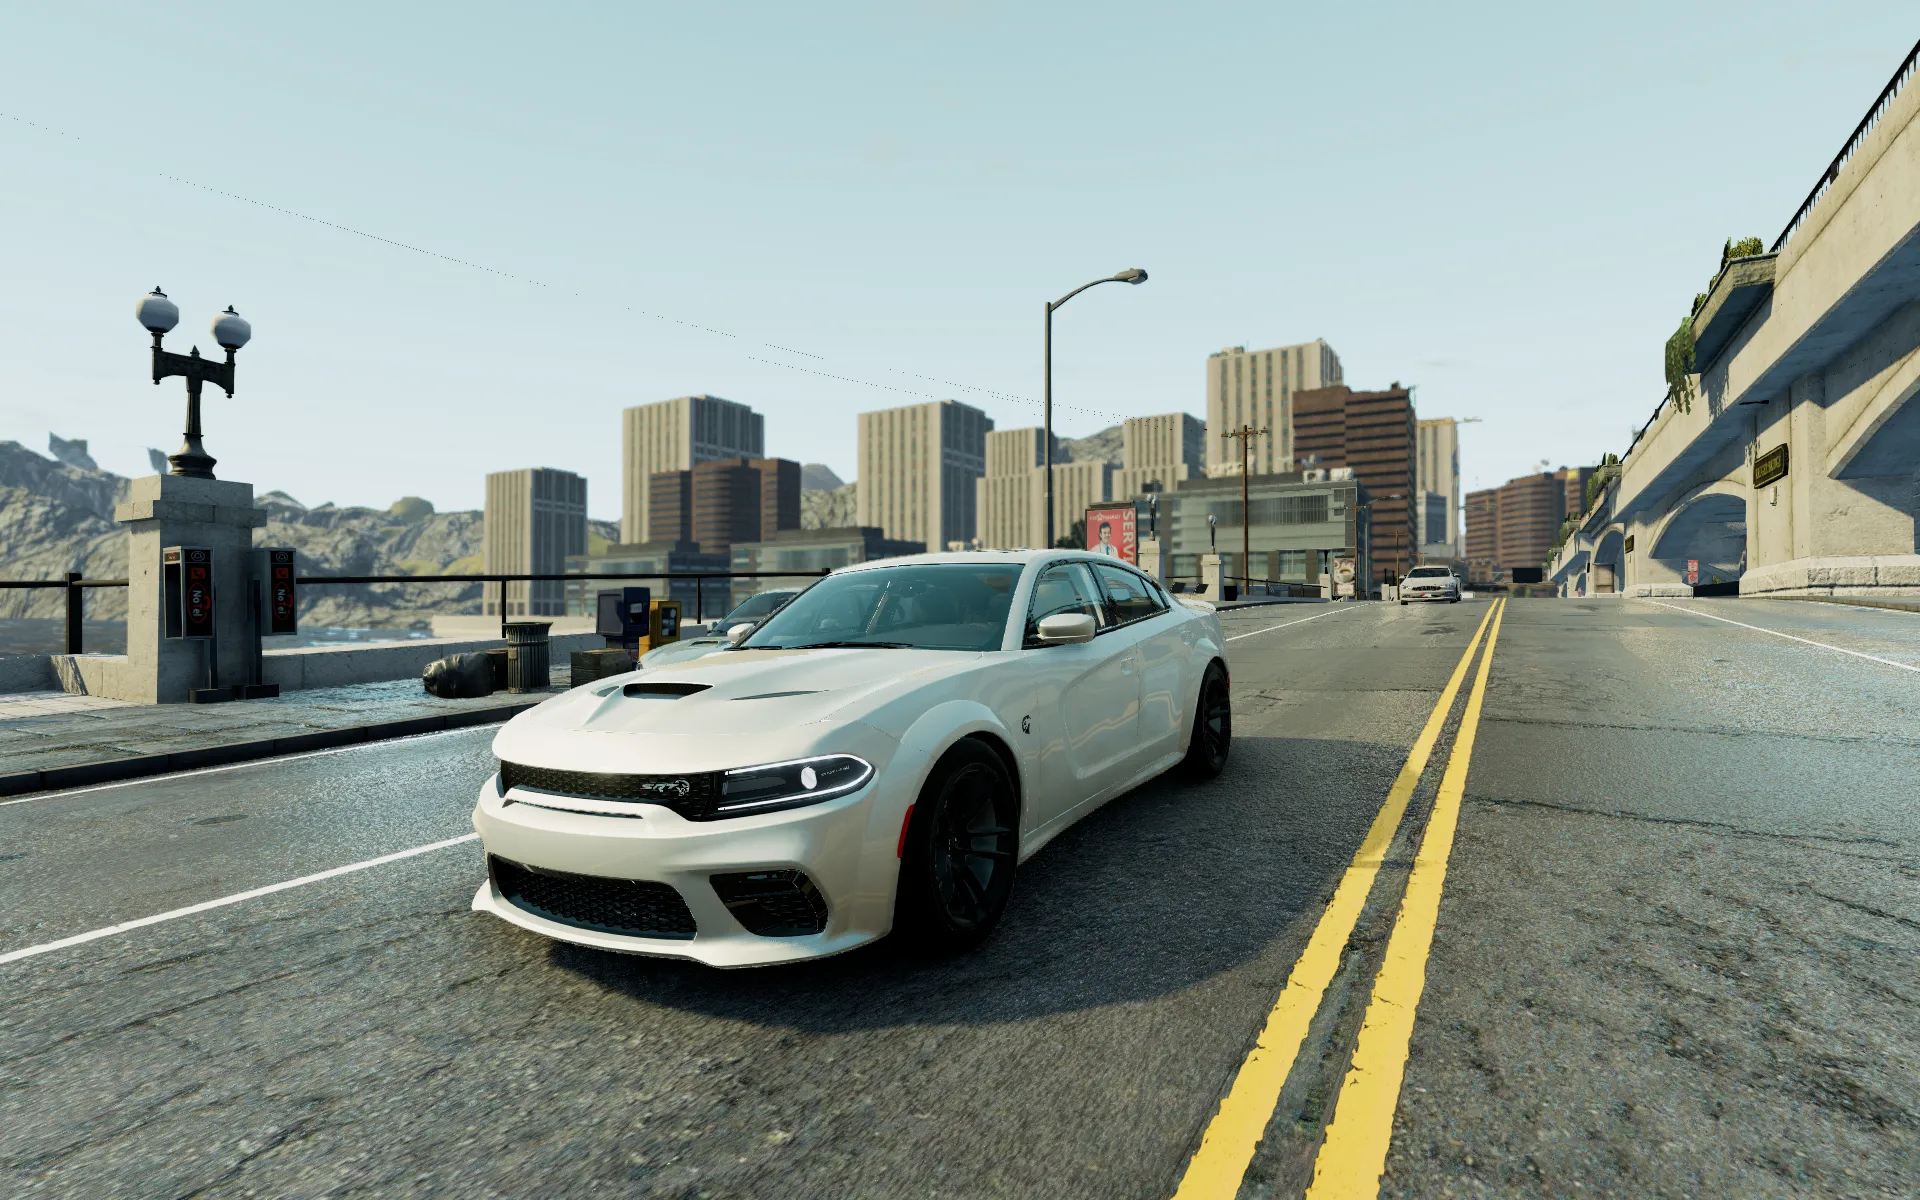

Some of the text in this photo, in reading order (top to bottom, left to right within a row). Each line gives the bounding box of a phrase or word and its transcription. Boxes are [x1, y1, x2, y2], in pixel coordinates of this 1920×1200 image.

[193, 590, 203, 617] NoTel
[278, 589, 286, 614] NoTel
[640, 783, 679, 792] SRT
